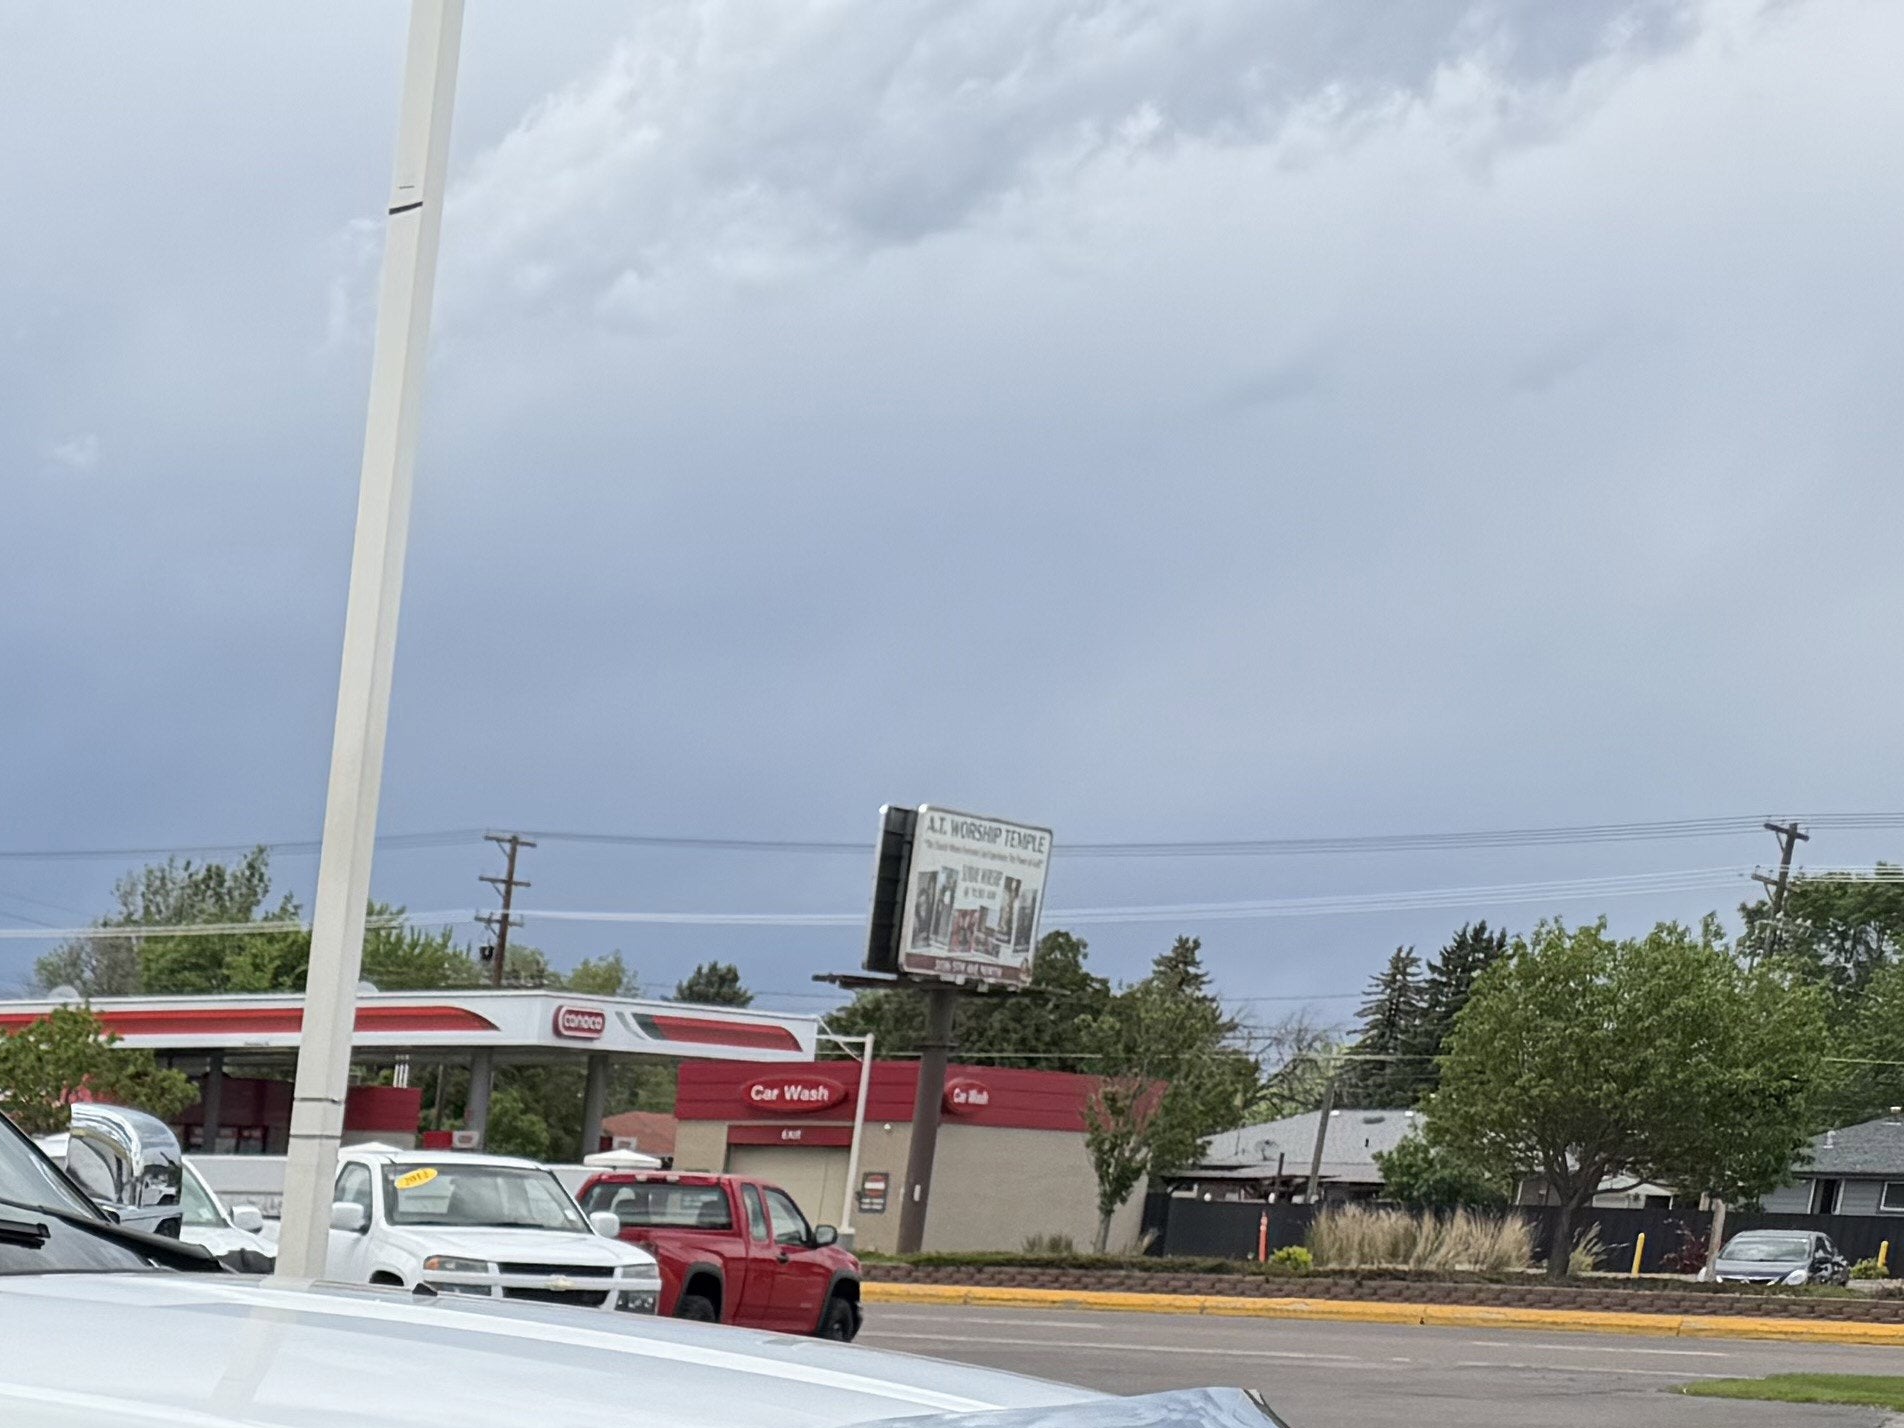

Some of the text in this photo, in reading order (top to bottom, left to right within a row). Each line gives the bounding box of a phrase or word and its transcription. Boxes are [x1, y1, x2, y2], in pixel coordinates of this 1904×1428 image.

[951, 819, 1002, 844] WORSHIP
[1004, 829, 1046, 854] TEMPLE
[750, 1085, 829, 1101] Car Wash
